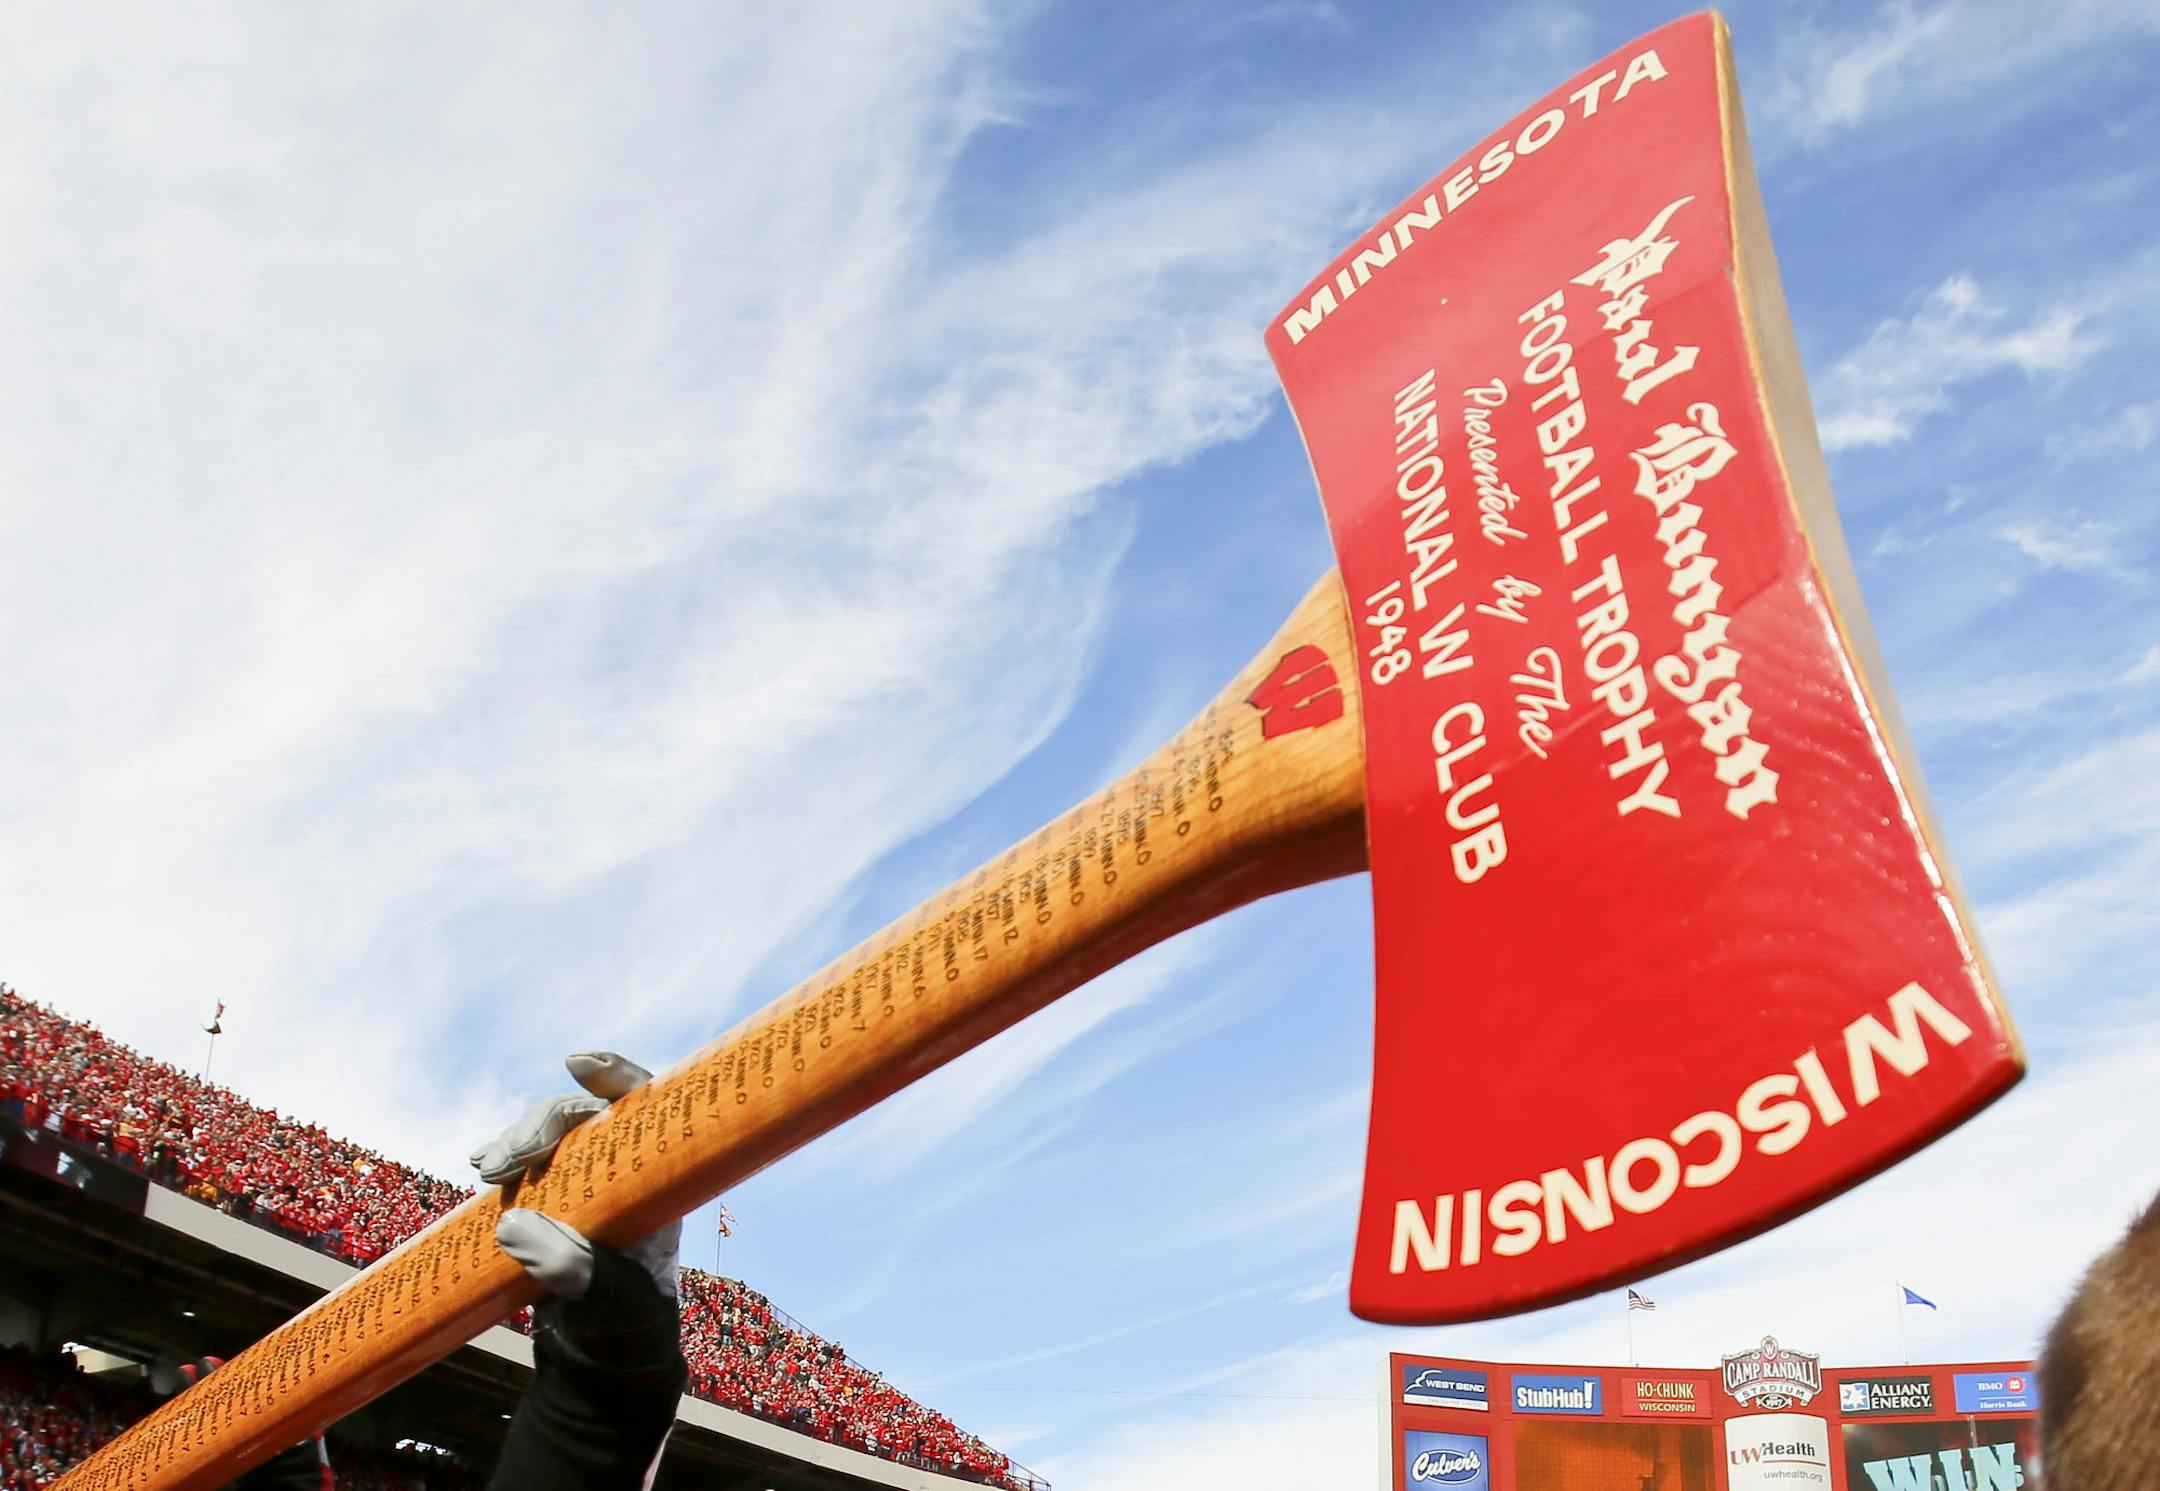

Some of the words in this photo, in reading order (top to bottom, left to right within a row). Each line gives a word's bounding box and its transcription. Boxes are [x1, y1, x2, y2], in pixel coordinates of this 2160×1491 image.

[1282, 48, 1670, 346] MINNESOTA
[1569, 194, 1701, 405] Paul
[1463, 377, 1528, 546] Presented
[1394, 368, 1459, 611] NATIONAL
[1517, 289, 1609, 565] FOOTBALL
[1571, 554, 1682, 818] TROPHY
[1476, 574, 1543, 624] by
[1628, 402, 1781, 820] Bunyan
[1366, 580, 1412, 686] 1948
[1419, 603, 1474, 679] W
[1509, 647, 1570, 759] The
[1431, 701, 1508, 884] CLUB
[1390, 981, 1973, 1275] WISCONSIN
[1426, 1379, 1456, 1390] WEST
[1456, 1382, 1485, 1393] BEND
[1516, 1381, 1596, 1410] StubHub!
[1636, 1381, 1695, 1399] HO-CHUNK
[1726, 1361, 1761, 1389] CAMP
[1763, 1360, 1819, 1390] RANDALL
[1742, 1384, 1805, 1398] STADIUM
[1870, 1383, 1930, 1397] ALLIANT
[1977, 1382, 2003, 1391] BMO
[1638, 1401, 1696, 1412] WISCONSIN
[1979, 1400, 2006, 1409] Harris
[2006, 1400, 2028, 1408] Bank
[1411, 1450, 1481, 1482] Culver's
[1763, 1469, 1824, 1482] uwhealth.org
